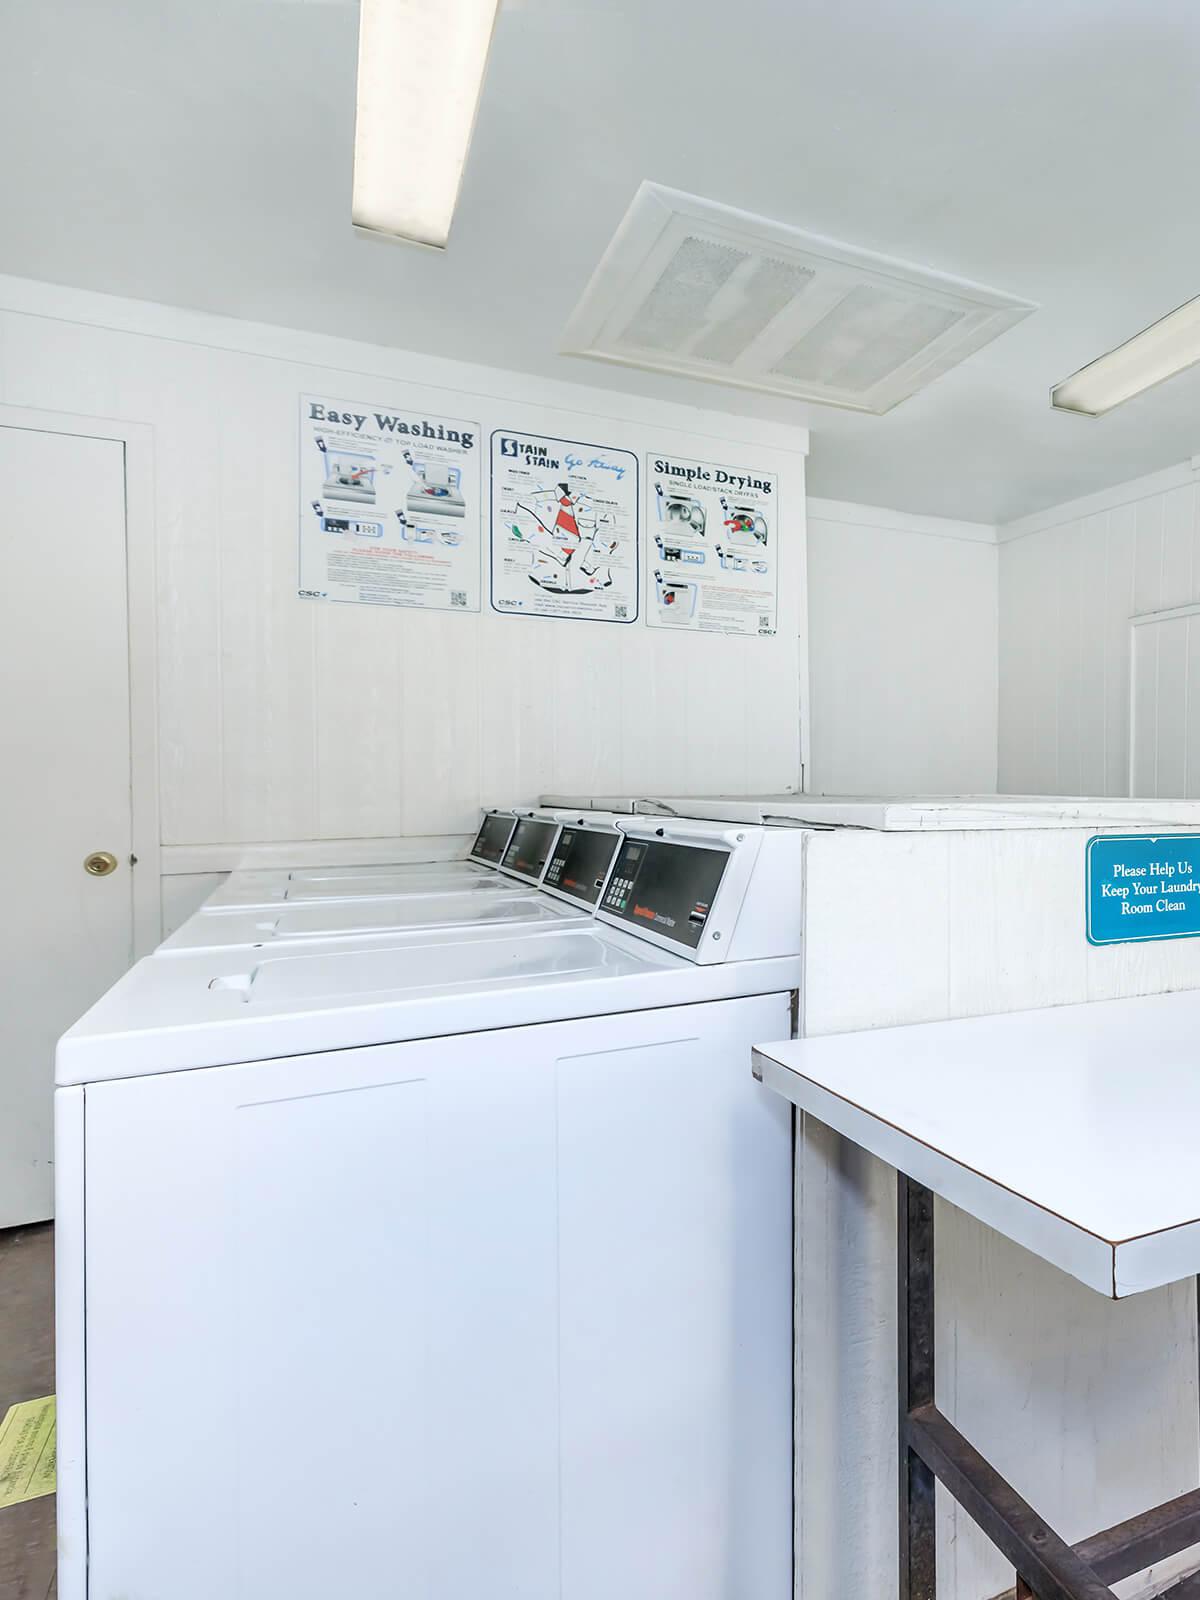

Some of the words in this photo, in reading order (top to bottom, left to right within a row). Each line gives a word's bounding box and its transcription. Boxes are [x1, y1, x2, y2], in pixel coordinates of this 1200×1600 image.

[308, 402, 367, 432] Easy
[373, 413, 474, 449] Washing
[313, 426, 382, 442] HIGH-EFFICIENCY
[395, 438, 412, 446] TOP
[412, 441, 434, 450] LOAD
[436, 445, 468, 455] WASHER
[525, 455, 560, 469] STAIN
[564, 453, 583, 471] Go
[587, 457, 626, 480] Away
[654, 459, 711, 482] Simple
[714, 470, 772, 494] Drying
[668, 480, 692, 489] SINGLE
[1113, 864, 1147, 878] Please
[1149, 862, 1175, 878] Help
[1177, 861, 1193, 874] Us
[1101, 884, 1130, 899] Keep
[1132, 882, 1158, 896] Your
[1121, 902, 1153, 915] Room
[1155, 899, 1186, 912] Clean
